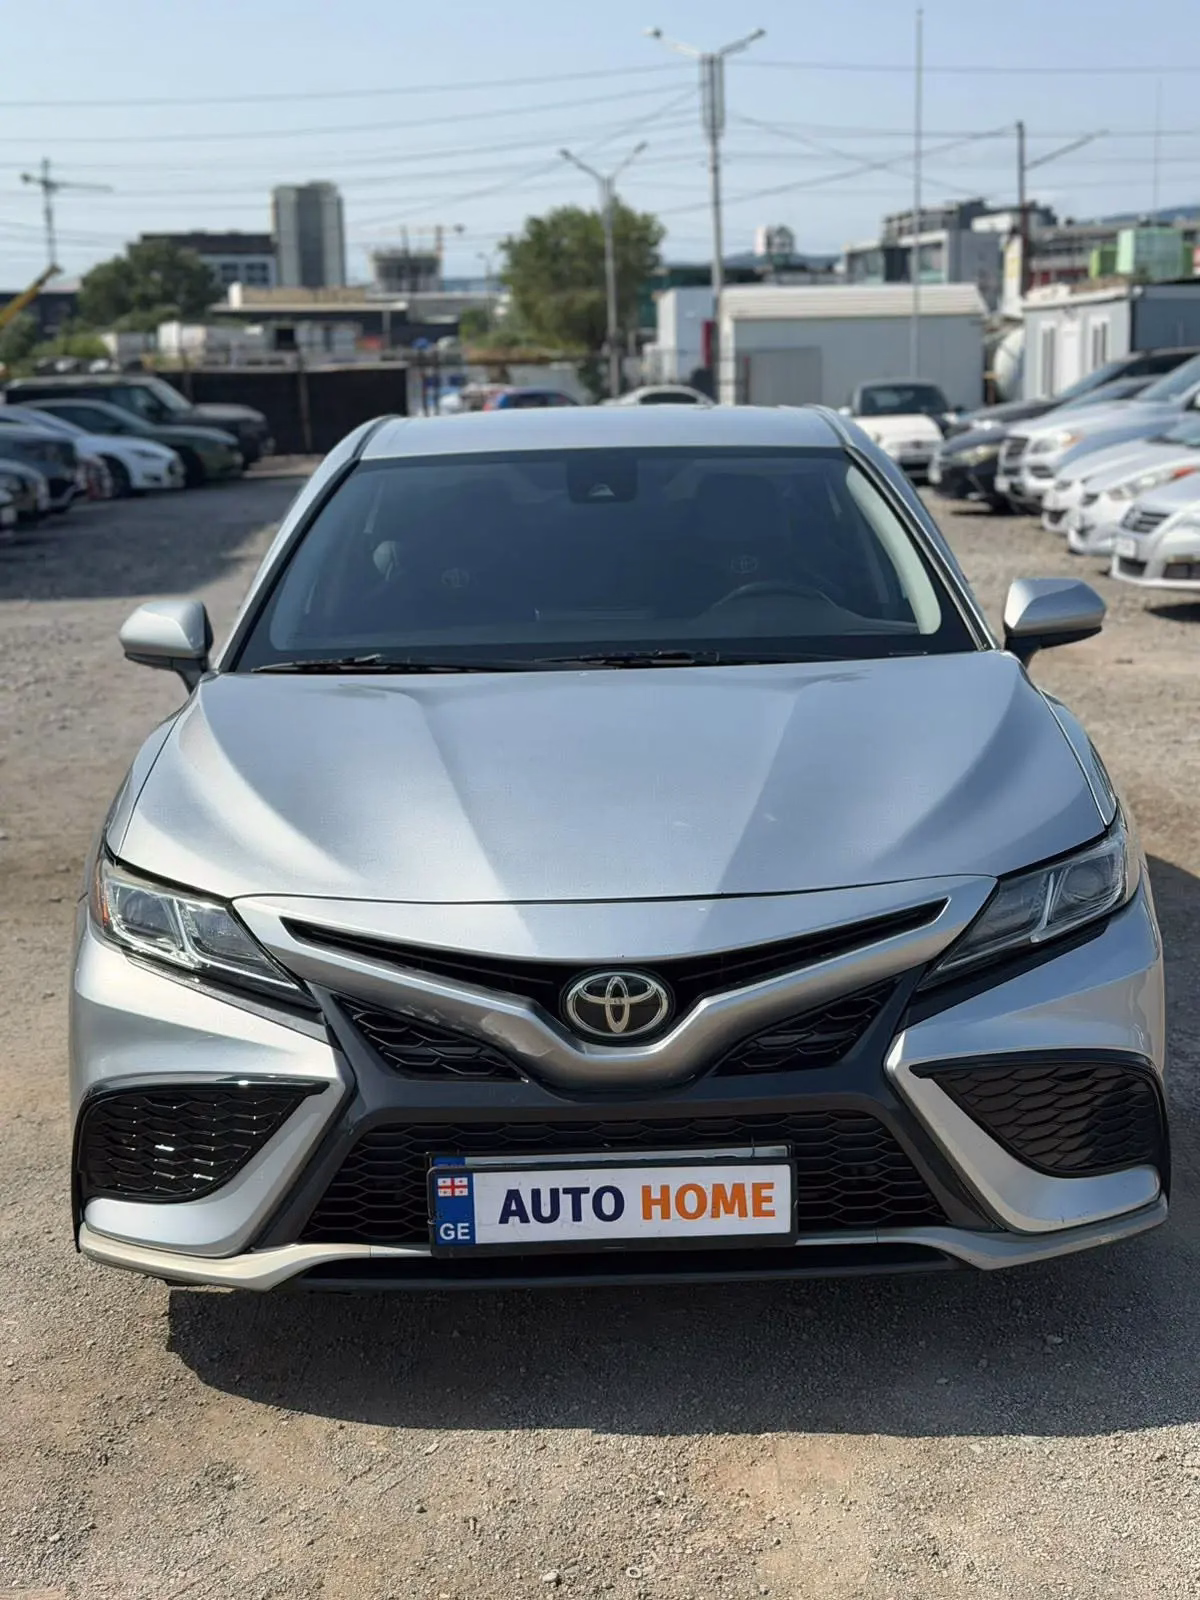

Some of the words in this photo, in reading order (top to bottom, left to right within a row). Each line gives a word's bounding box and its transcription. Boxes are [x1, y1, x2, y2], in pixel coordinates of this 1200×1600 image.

[498, 1186, 625, 1225] AUTO
[641, 1182, 776, 1221] HOME
[438, 1222, 470, 1241] GE
